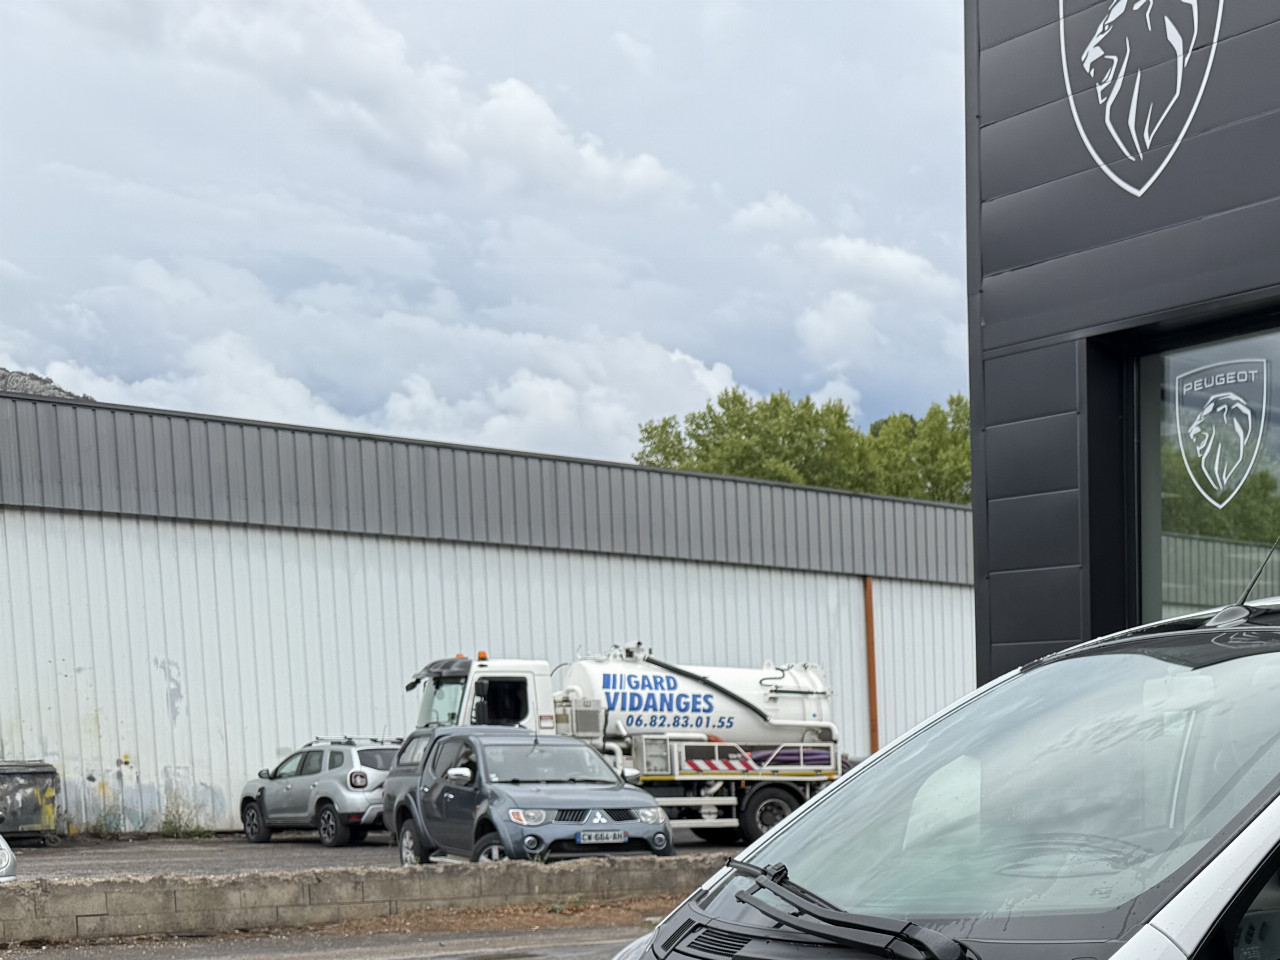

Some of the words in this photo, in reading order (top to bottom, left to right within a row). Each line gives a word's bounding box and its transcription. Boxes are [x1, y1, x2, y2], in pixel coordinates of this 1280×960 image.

[1183, 370, 1258, 395] PEUGEOT
[604, 692, 714, 713] VIDANGES
[626, 715, 734, 729] 06.82.83.01.55
